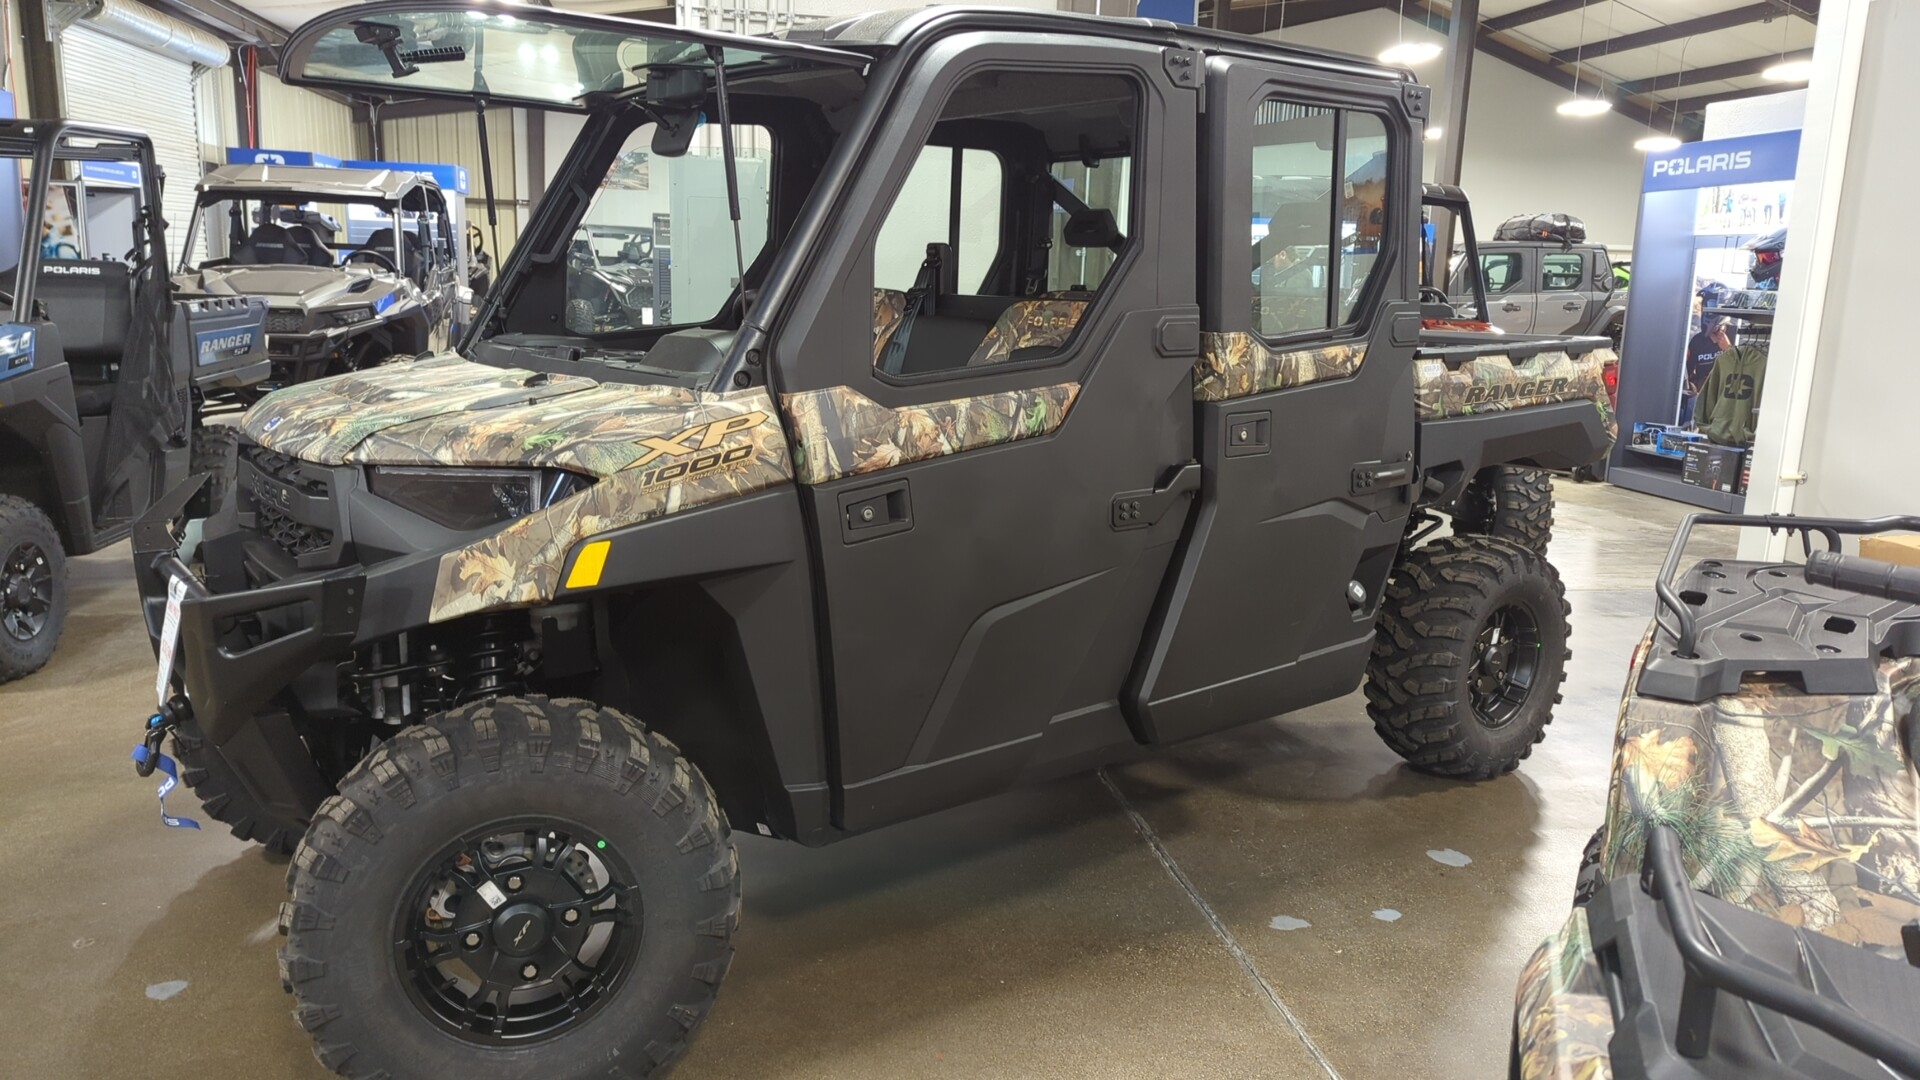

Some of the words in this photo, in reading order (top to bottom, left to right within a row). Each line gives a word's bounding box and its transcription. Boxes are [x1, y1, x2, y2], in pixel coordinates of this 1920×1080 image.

[1653, 151, 1752, 178] POLARIS
[43, 266, 101, 275] POLARIS
[201, 333, 251, 353] RANGER
[1463, 377, 1569, 405] RANGER
[613, 410, 769, 474] XP
[640, 444, 754, 489] 1000
